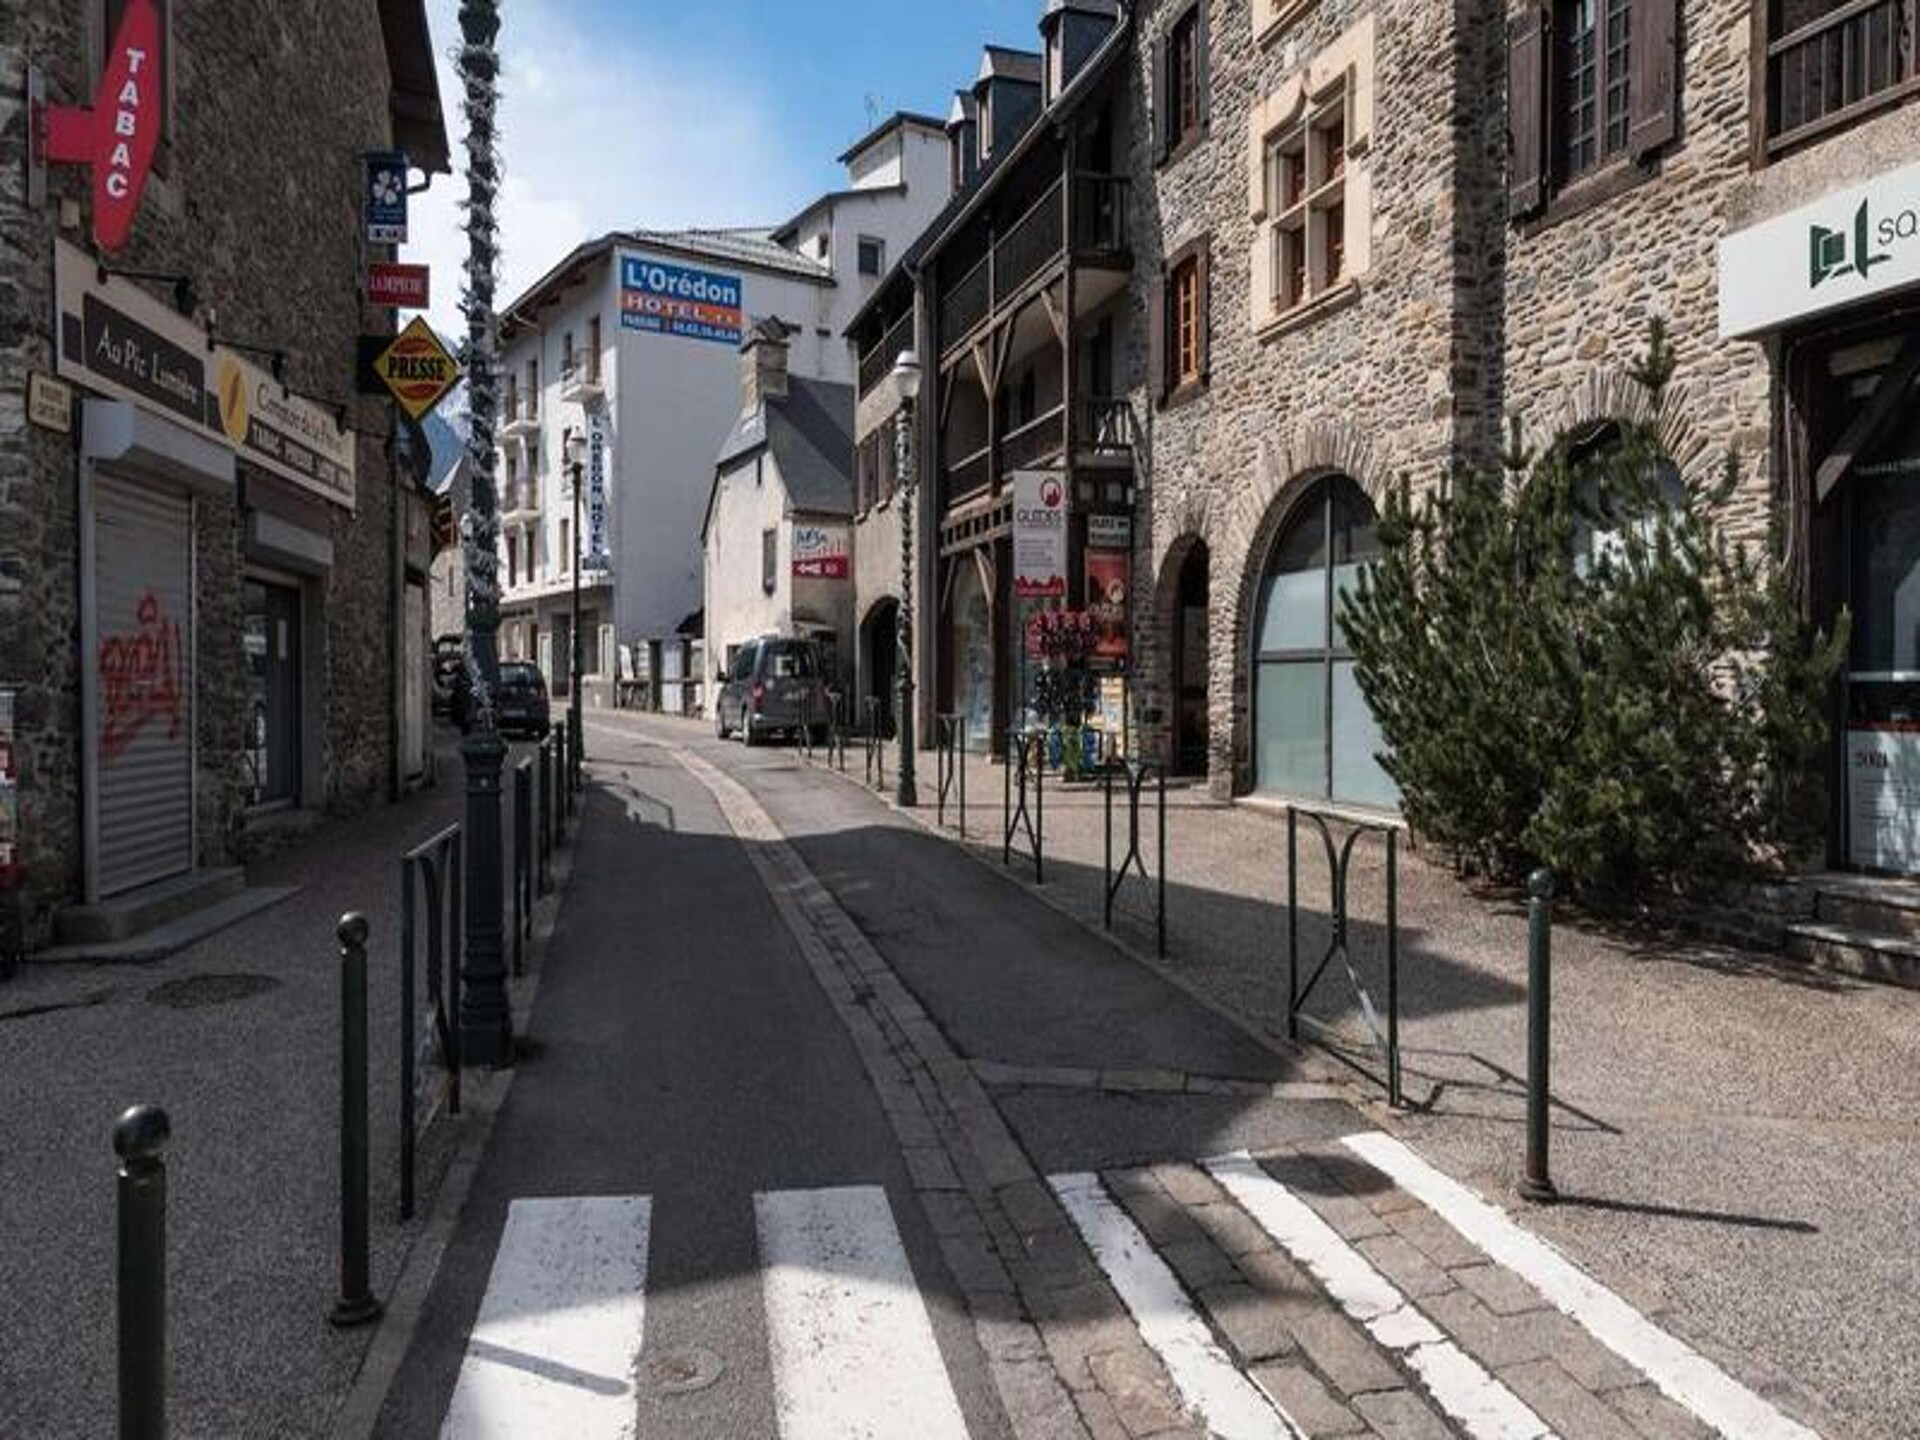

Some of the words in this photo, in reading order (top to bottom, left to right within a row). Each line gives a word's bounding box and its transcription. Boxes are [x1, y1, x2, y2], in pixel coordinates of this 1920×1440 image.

[106, 48, 146, 197] TABAC
[628, 263, 737, 305] L'Orédon
[628, 293, 706, 320] HOTEL
[96, 322, 121, 364] Au
[123, 338, 148, 378] Pic
[388, 355, 445, 382] PRESSE
[591, 503, 603, 554] HOTEL
